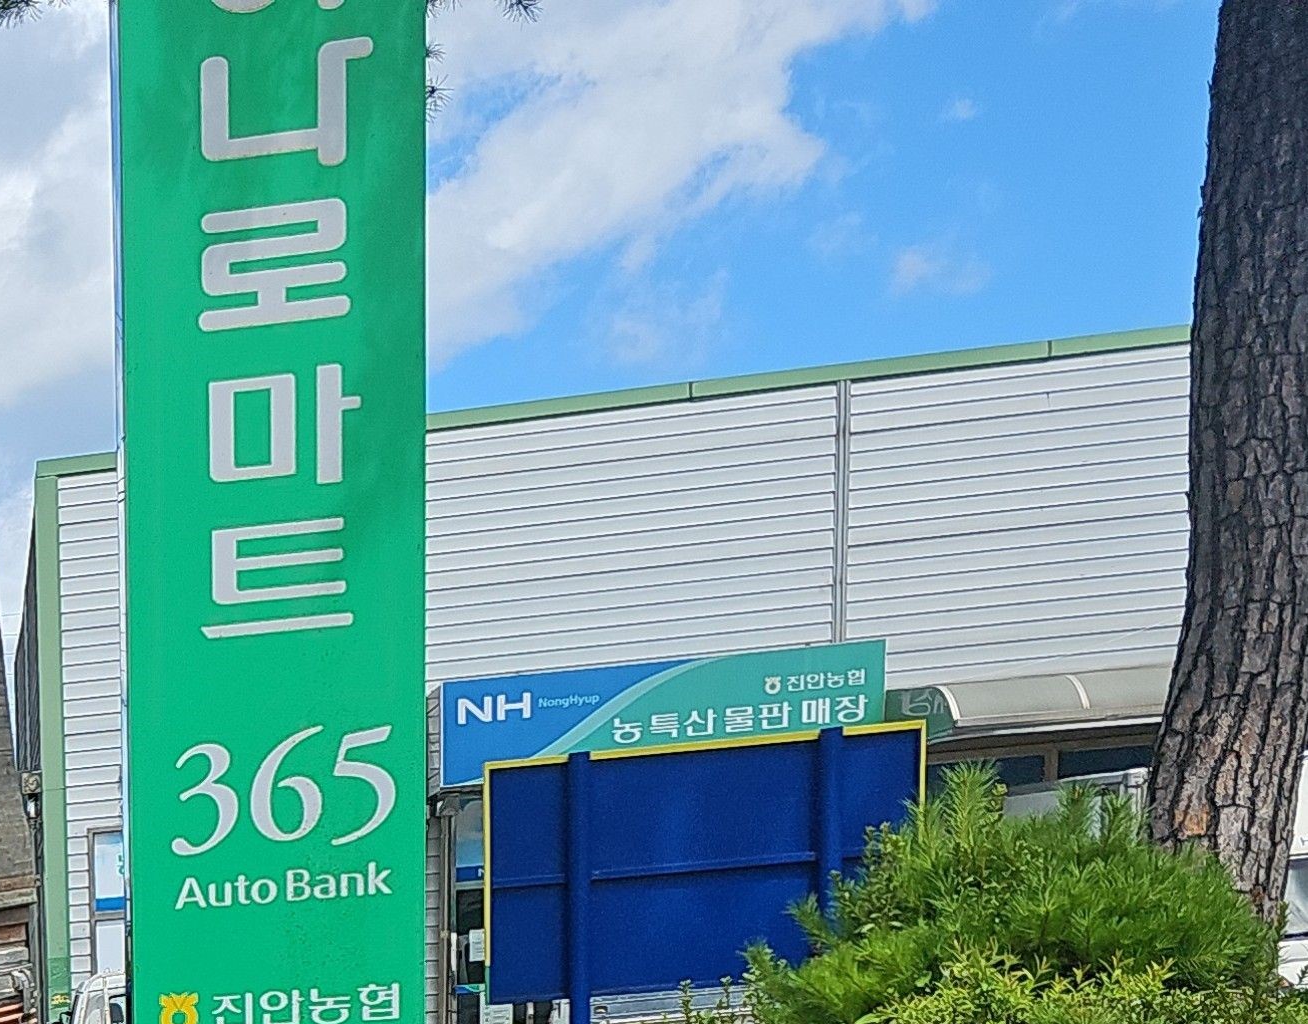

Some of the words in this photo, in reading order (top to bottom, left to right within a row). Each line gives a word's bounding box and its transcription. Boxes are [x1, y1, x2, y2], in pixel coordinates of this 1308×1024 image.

[198, 0, 373, 639] 나로마트
[786, 668, 866, 692] 진안농협
[457, 691, 532, 725] NH
[538, 694, 600, 709] NongHyup
[171, 725, 396, 857] 365
[174, 874, 278, 910] Auto
[285, 861, 393, 902] Bank
